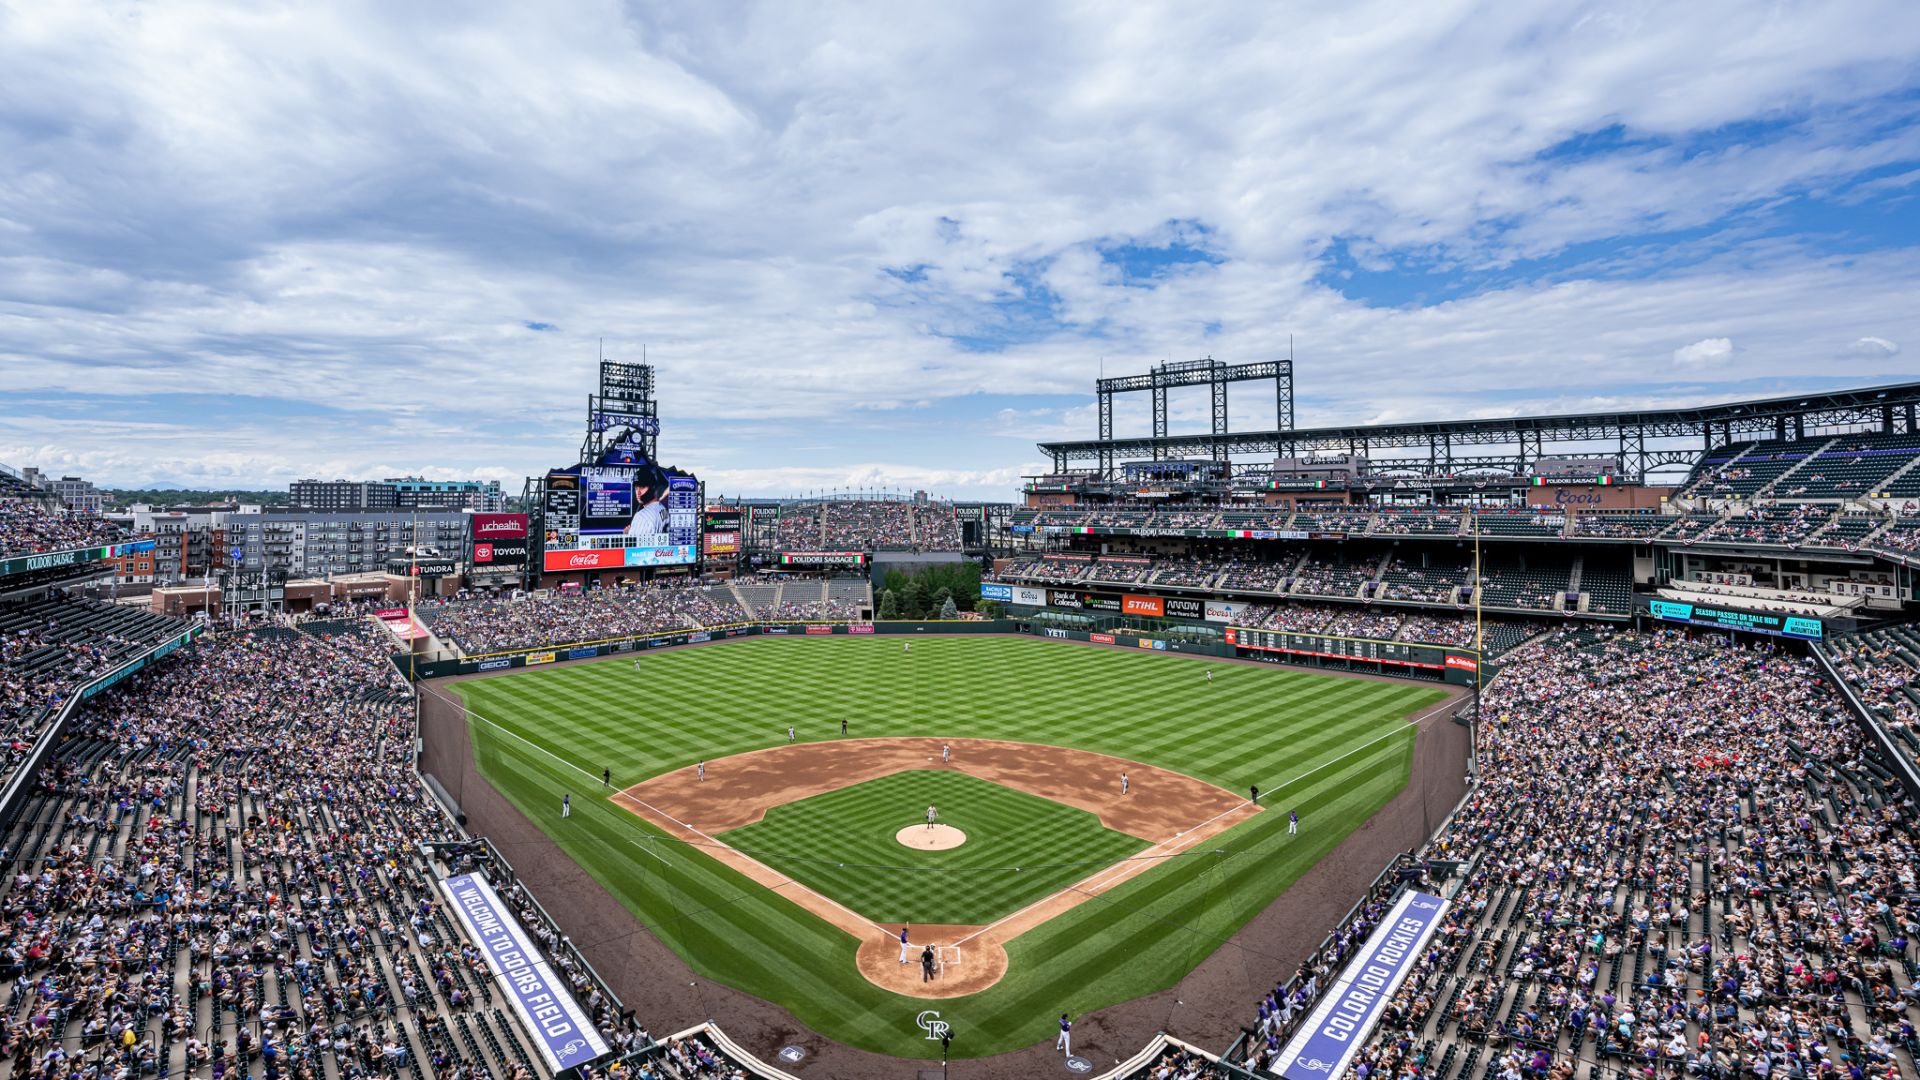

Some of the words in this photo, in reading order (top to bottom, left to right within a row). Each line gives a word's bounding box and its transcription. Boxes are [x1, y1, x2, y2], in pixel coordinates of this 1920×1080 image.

[1555, 489, 1602, 504] Coors
[482, 520, 521, 531] uchealth
[1130, 528, 1157, 537] POLIDORI
[1158, 528, 1186, 536] SAUSAGE
[710, 534, 735, 544] KING
[493, 547, 526, 556] TOYOTA
[655, 548, 674, 557] Chill
[26, 555, 52, 571] POLIDORI
[52, 552, 75, 566] SAUSAGE
[792, 555, 822, 563] POLIDORI
[824, 555, 854, 563] SAUSAGE
[419, 565, 453, 574] TUNDRA
[1053, 591, 1069, 599] Bank
[1069, 592, 1076, 600] of
[1053, 598, 1081, 608] Colorado
[1127, 600, 1159, 611] STIHL
[1206, 607, 1229, 618] Coors
[1695, 608, 1717, 617] SEASON
[1716, 610, 1738, 620] PASSES
[1739, 613, 1748, 621] ON
[1748, 614, 1764, 624] SALE
[1764, 616, 1779, 625] NOW
[1046, 628, 1066, 638] YETI
[1791, 625, 1820, 635] MOUNTAIN
[480, 660, 510, 670] GEICO
[458, 887, 499, 937] WELCOME
[489, 935, 512, 953] TO
[1374, 917, 1424, 967] ROCKIES
[500, 950, 544, 995] COORS
[1322, 965, 1391, 1042] COLORADO
[527, 995, 572, 1038] FIELD
